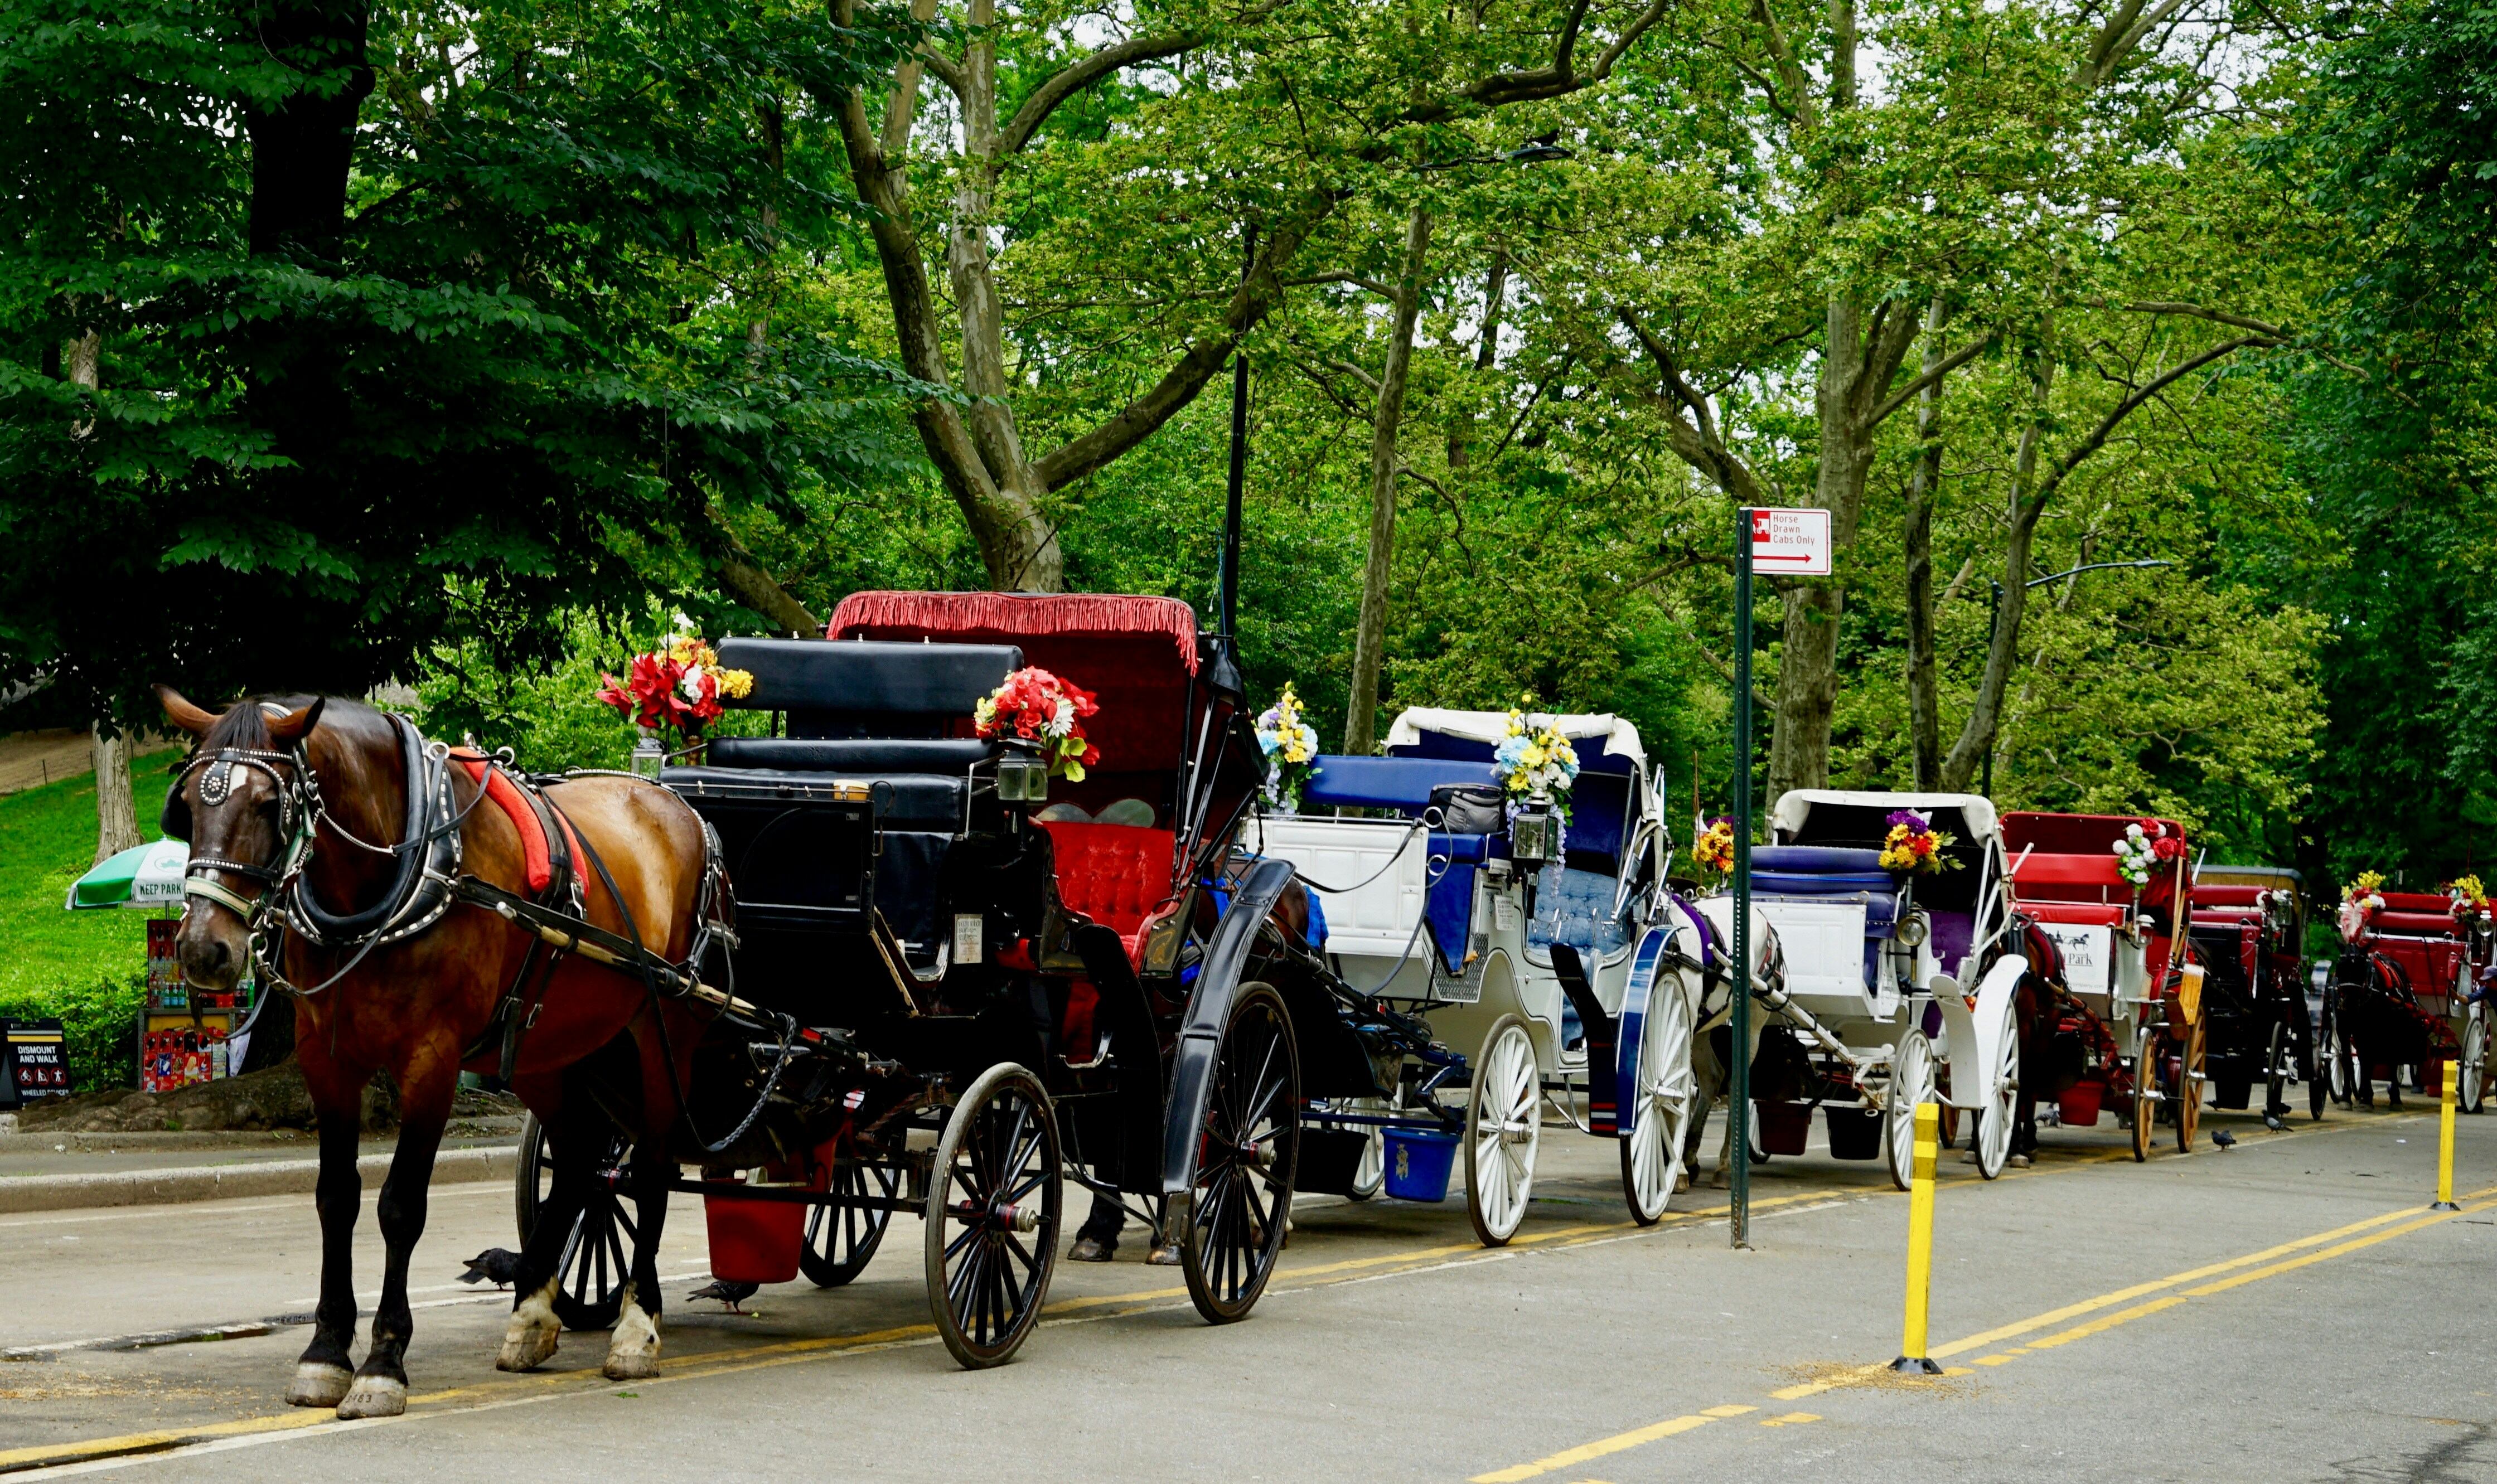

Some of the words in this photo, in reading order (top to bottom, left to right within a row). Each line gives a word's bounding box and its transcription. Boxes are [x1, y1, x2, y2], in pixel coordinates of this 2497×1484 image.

[1773, 514, 1798, 523] Horse
[1773, 524, 1800, 533] Drawn
[1773, 535, 1793, 544] Cabs
[1797, 535, 1815, 547] Only
[140, 883, 158, 895] KEEP
[161, 883, 182, 894] PARK
[2069, 953, 2092, 964] Park
[17, 1045, 56, 1054] DISMOUNT
[20, 1055, 35, 1063] AND
[36, 1055, 58, 1063] WALK
